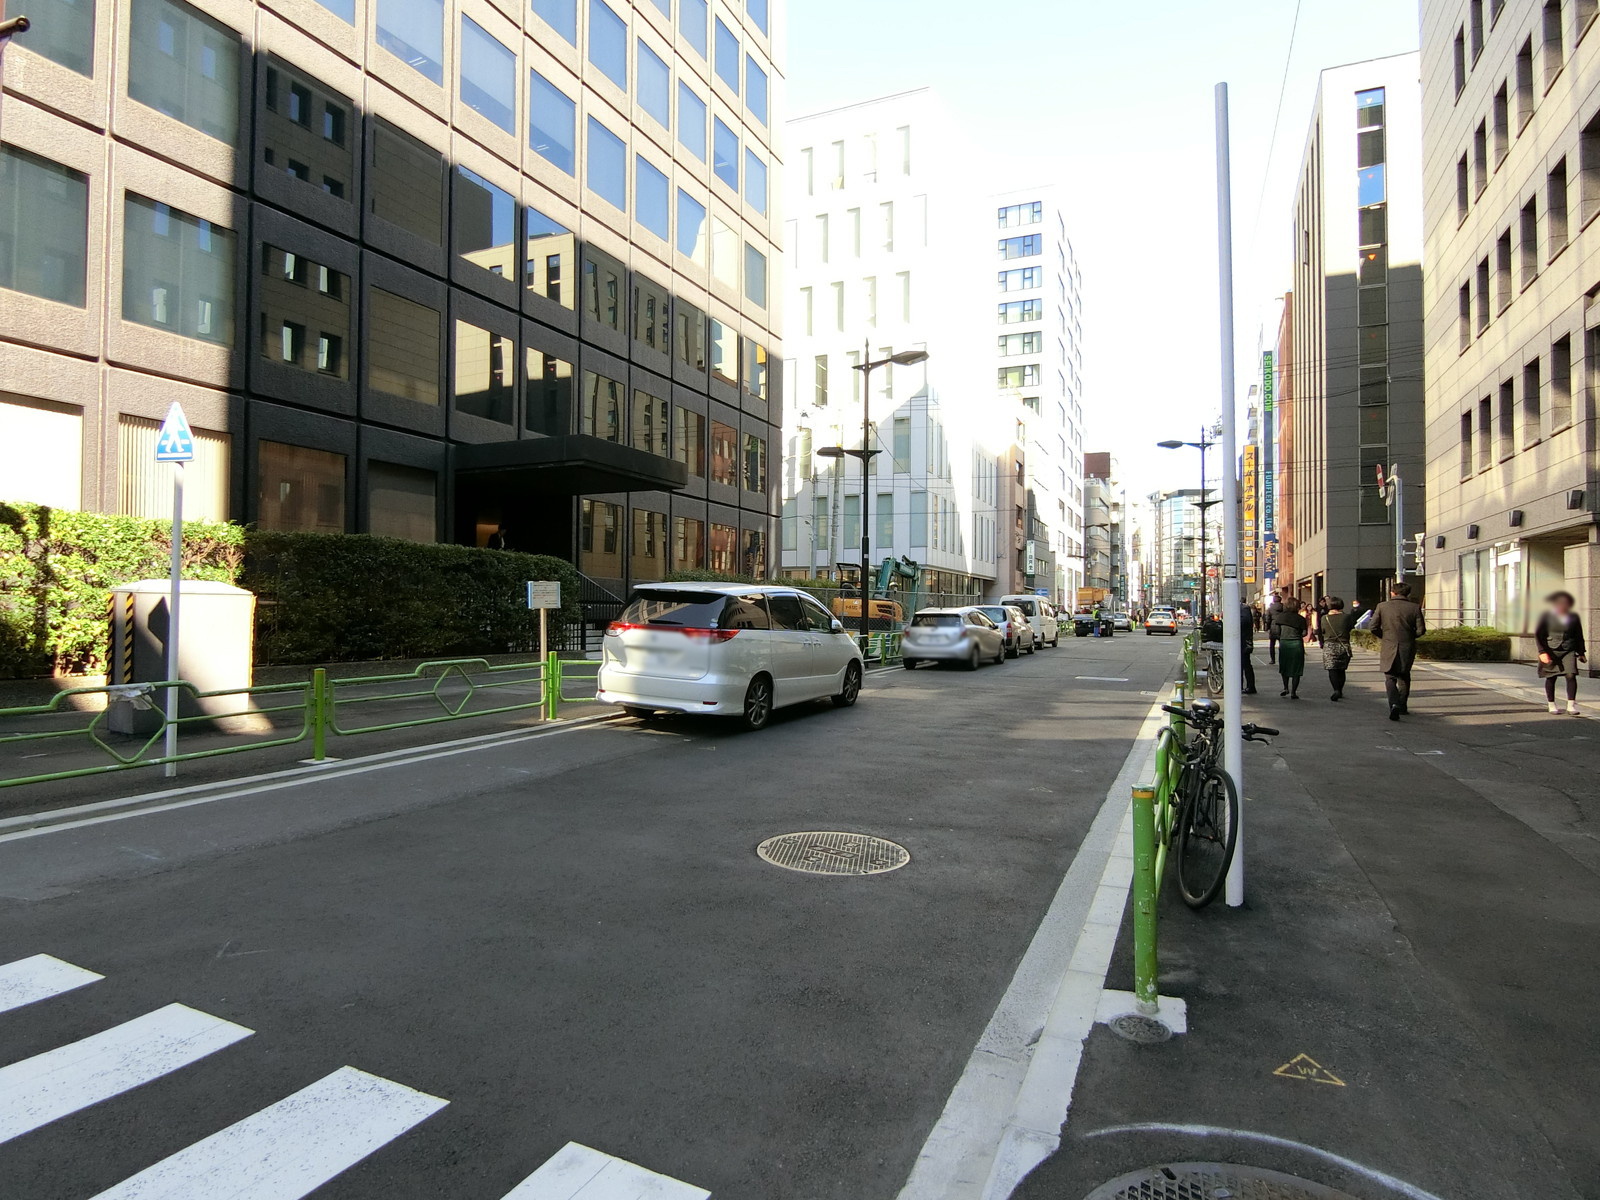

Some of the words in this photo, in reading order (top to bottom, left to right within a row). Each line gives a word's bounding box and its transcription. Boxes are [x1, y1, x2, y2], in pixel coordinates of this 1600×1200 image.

[1264, 355, 1272, 412] SEIKODO.COM
[1245, 452, 1254, 511] スーパーホテル
